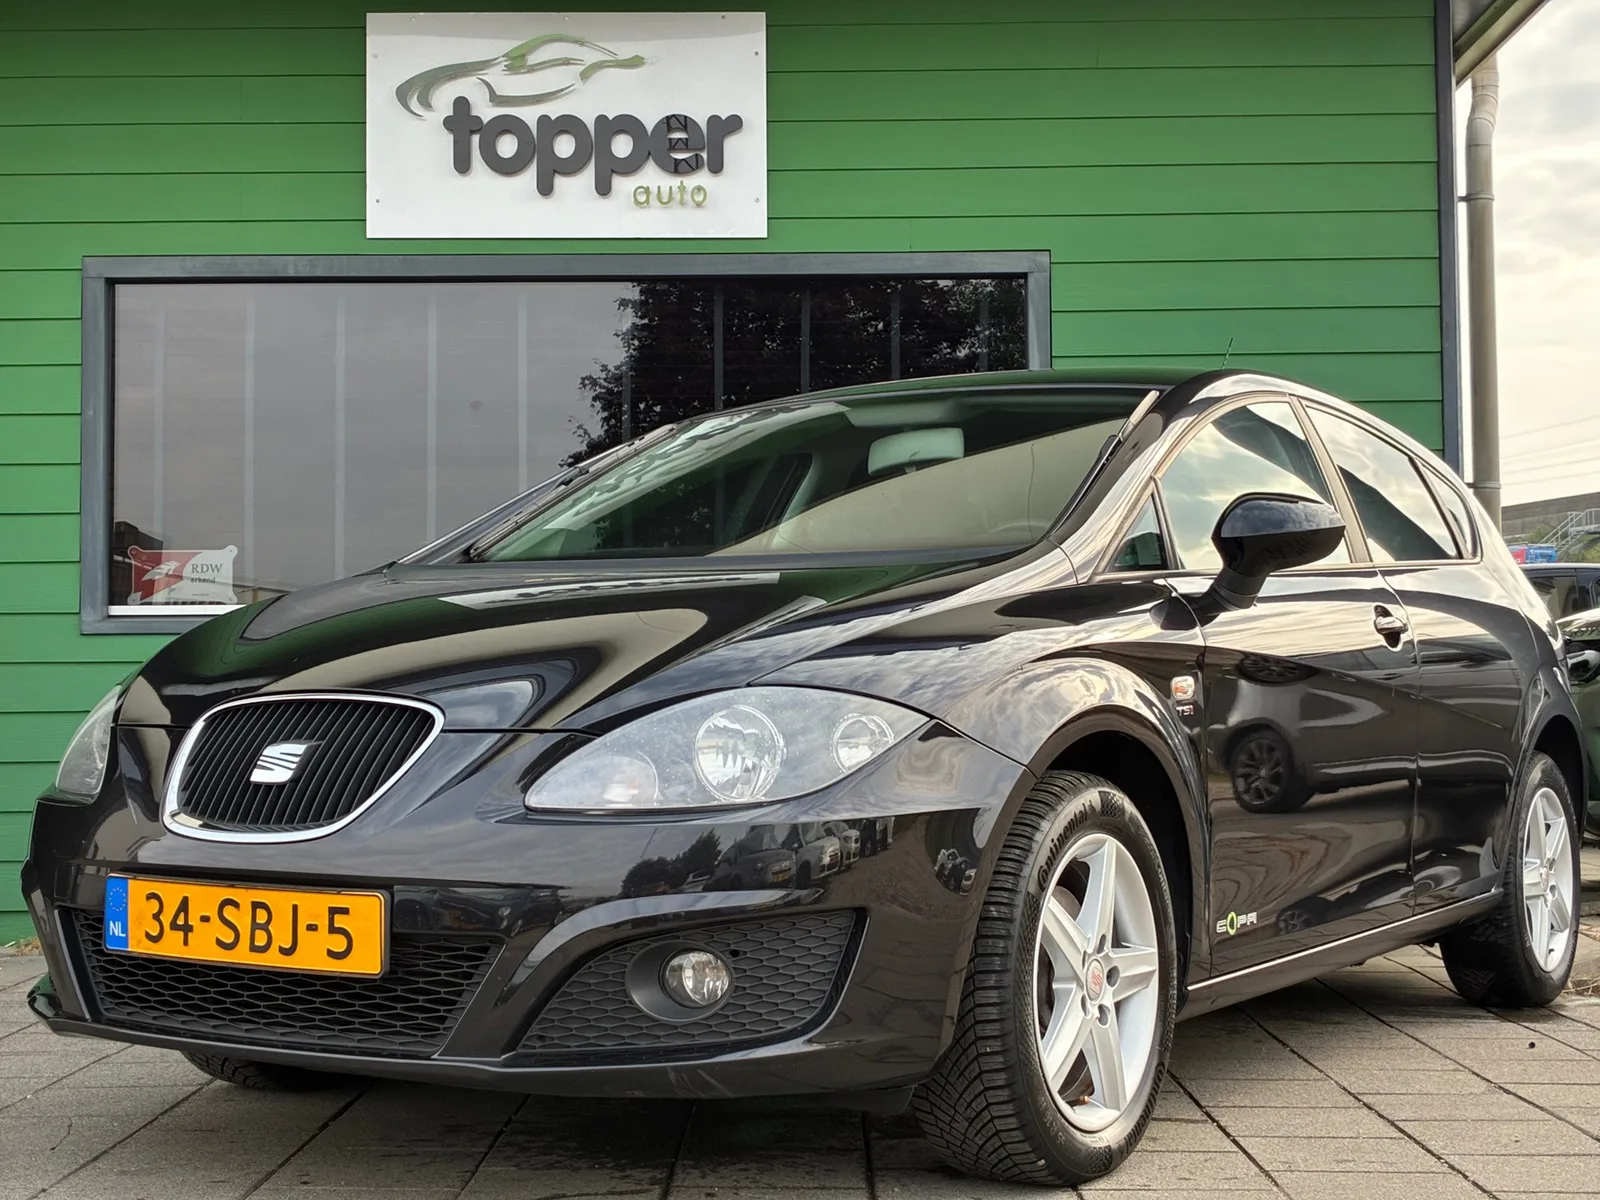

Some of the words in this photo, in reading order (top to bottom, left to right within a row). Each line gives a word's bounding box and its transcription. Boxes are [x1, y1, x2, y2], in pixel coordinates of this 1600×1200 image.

[443, 95, 743, 197] topper
[633, 180, 708, 208] auto
[190, 576, 216, 584] erkend
[191, 563, 223, 574] RDW
[1037, 802, 1088, 892] Continental
[109, 920, 126, 937] NL
[144, 891, 354, 960] 34-SBJ-5
